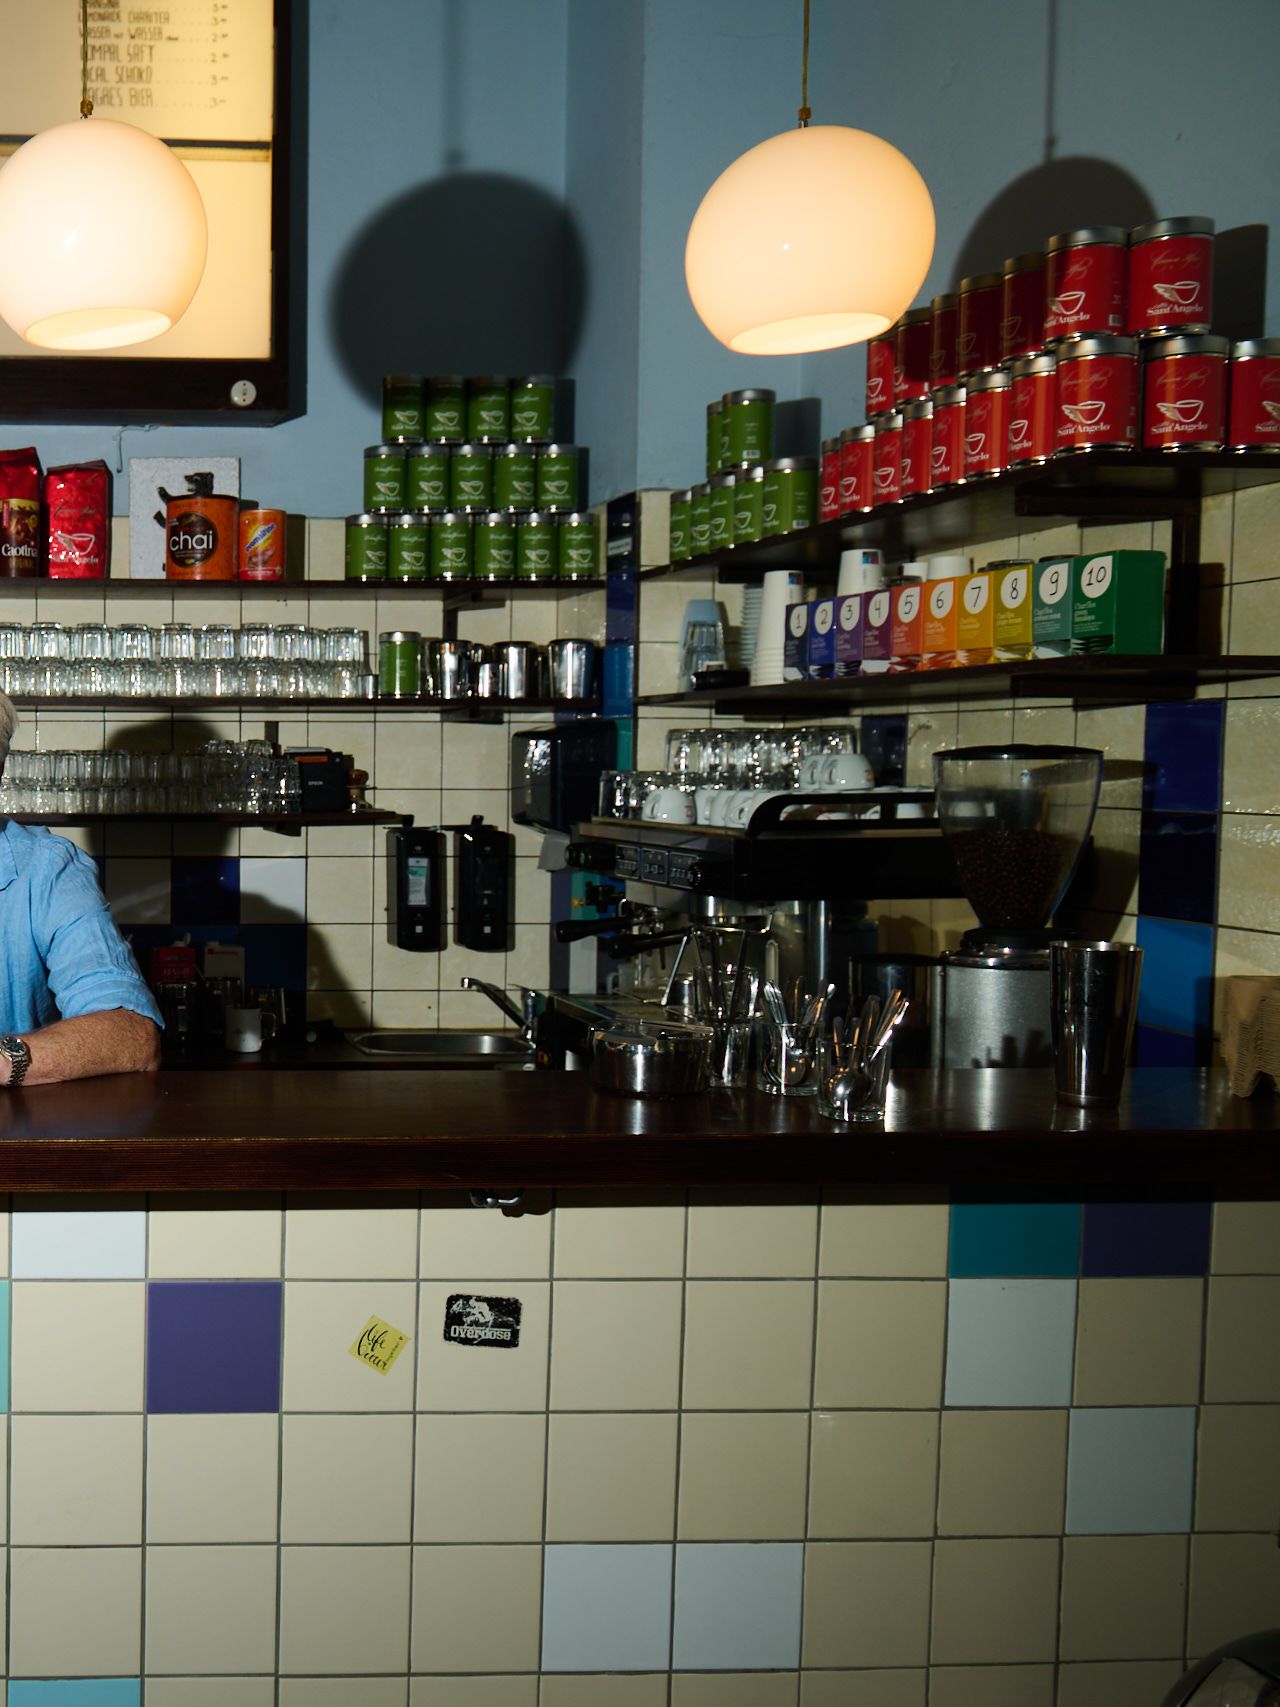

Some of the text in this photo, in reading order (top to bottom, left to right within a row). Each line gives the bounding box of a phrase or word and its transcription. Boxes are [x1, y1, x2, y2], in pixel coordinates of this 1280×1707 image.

[1049, 570, 1060, 596] 9
[1085, 566, 1107, 587] 10
[971, 585, 982, 608] 7
[1010, 577, 1019, 600] 8
[904, 594, 914, 615] 5
[936, 590, 944, 609] 6
[820, 608, 829, 626] 2
[845, 604, 854, 621] 3
[450, 1325, 512, 1341] Overdose
